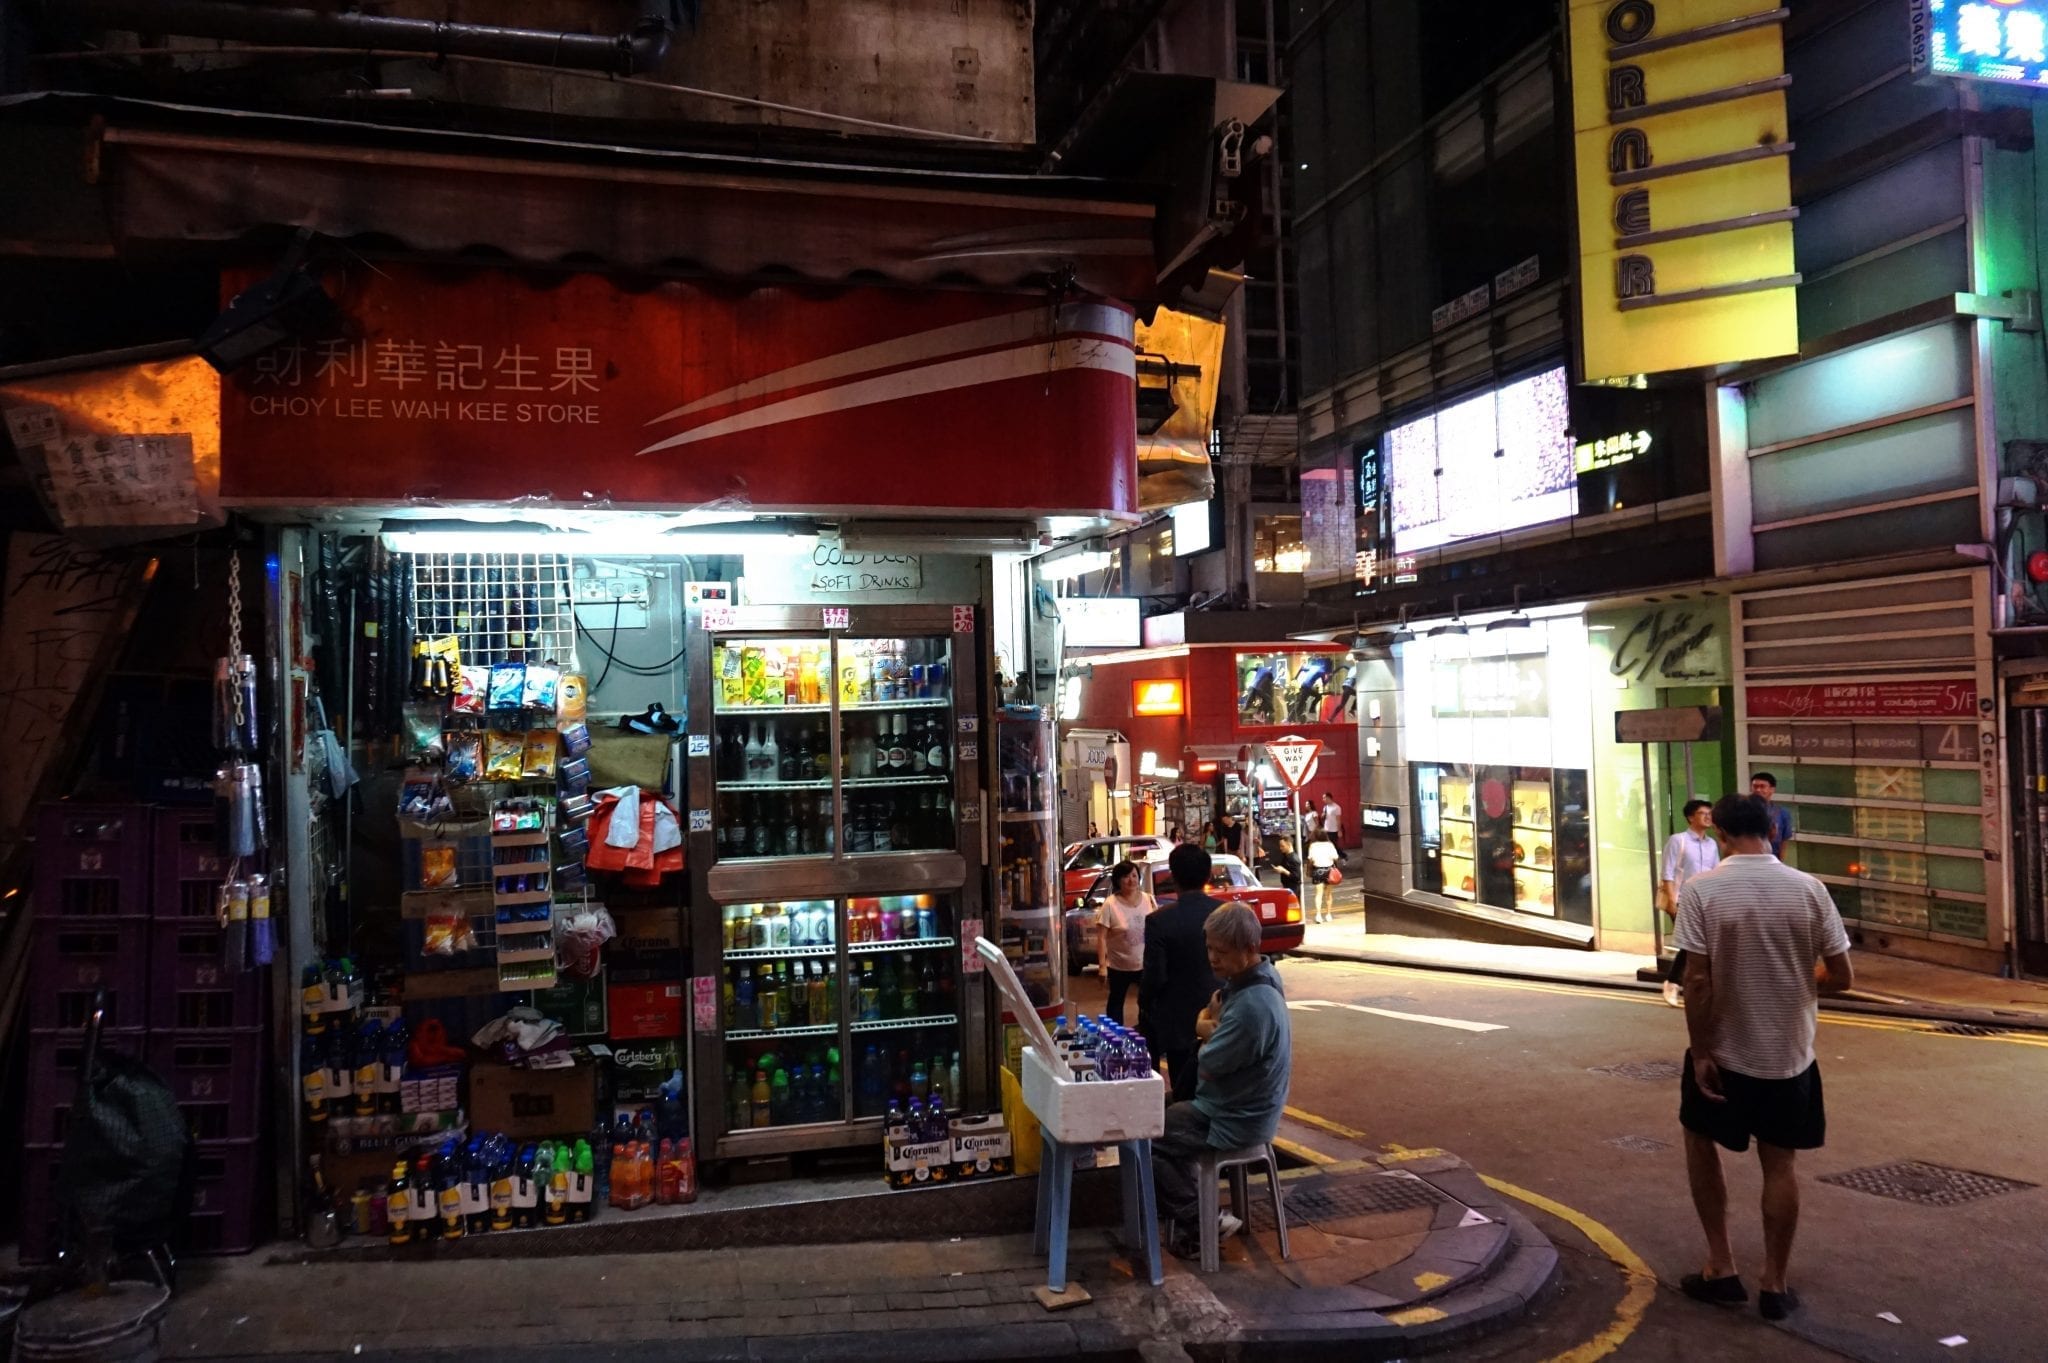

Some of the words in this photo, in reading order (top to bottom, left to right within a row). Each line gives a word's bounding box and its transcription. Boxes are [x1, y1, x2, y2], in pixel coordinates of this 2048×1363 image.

[251, 338, 601, 395] 財利華記生果
[250, 396, 331, 416] CHOY
[335, 399, 383, 419] LEE
[391, 400, 450, 420] WAH
[459, 402, 508, 422] KEE
[516, 403, 601, 424] STORE
[813, 575, 852, 590] SOFT
[859, 573, 910, 590] DRINKS
[1759, 734, 1792, 747] CAPA
[614, 1048, 663, 1067] Carlsberg
[903, 1145, 940, 1160] Corona
[964, 1137, 1001, 1151] Corona
